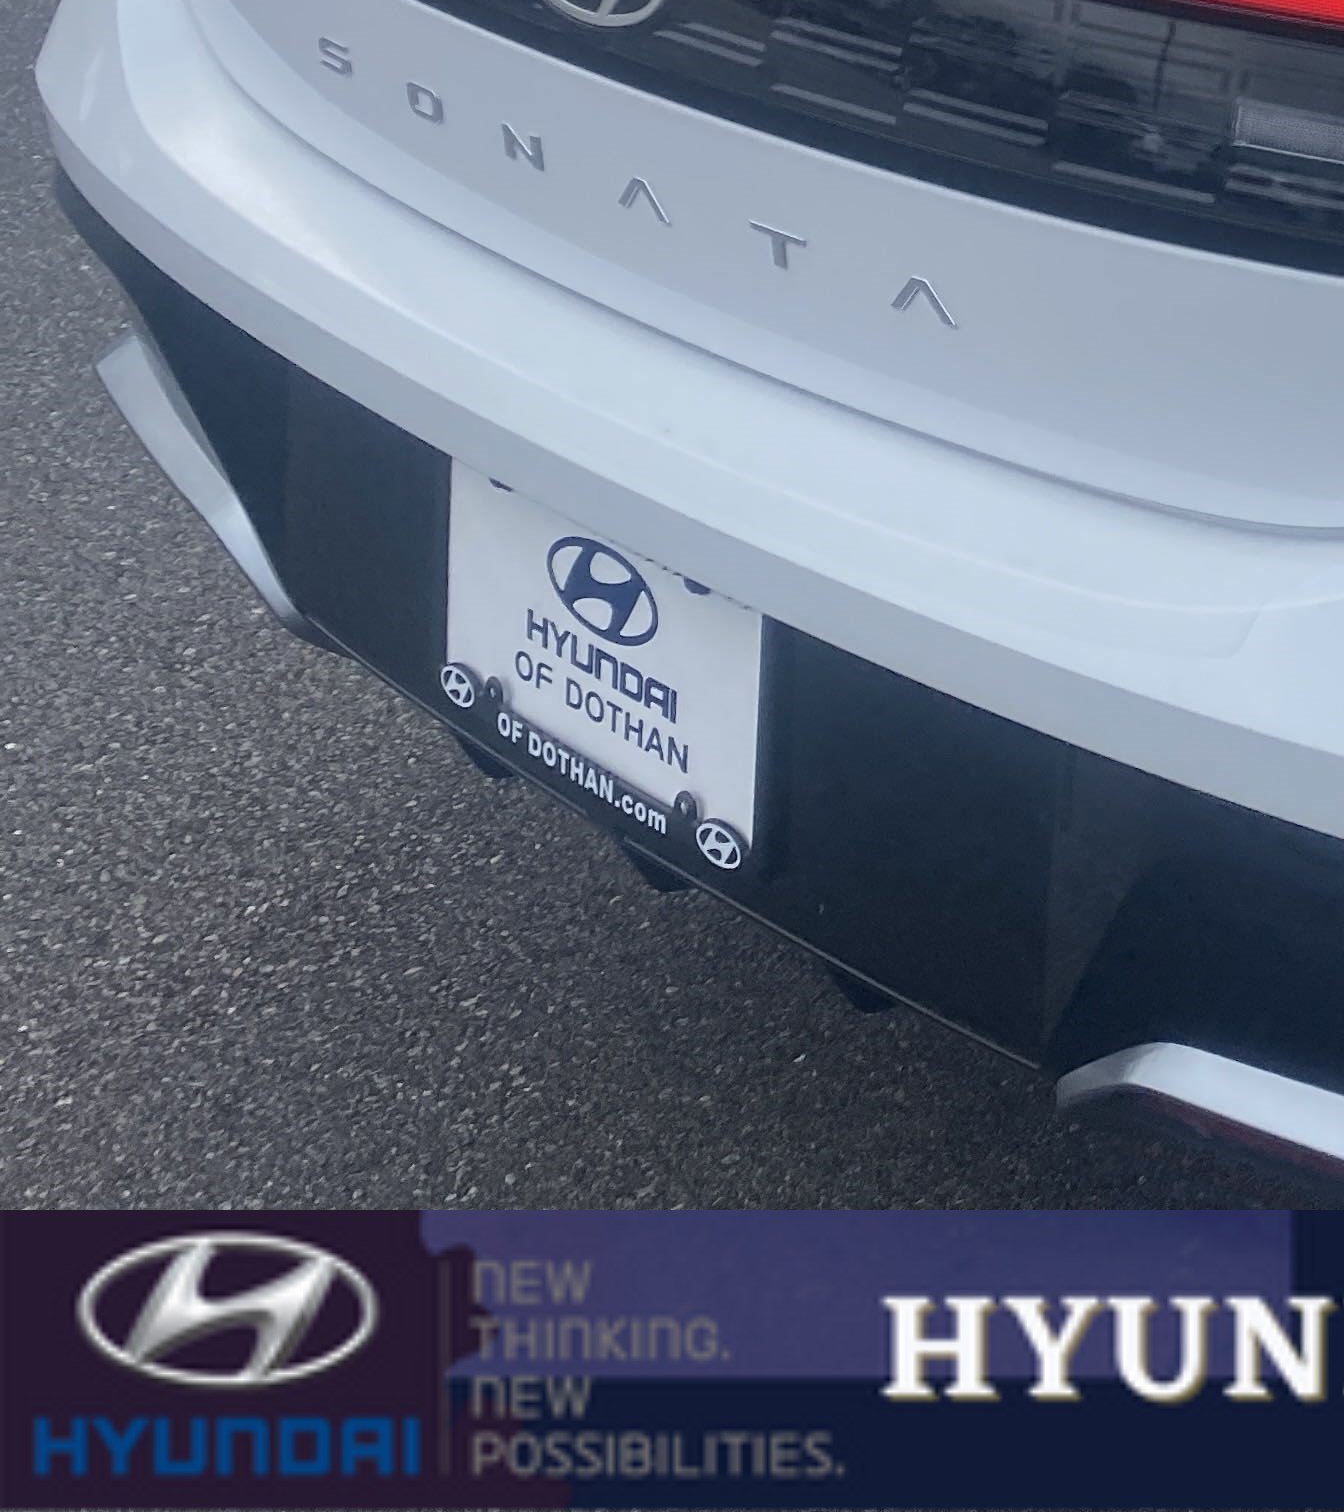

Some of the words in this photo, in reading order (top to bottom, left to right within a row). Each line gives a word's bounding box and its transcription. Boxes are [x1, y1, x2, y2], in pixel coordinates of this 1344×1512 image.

[318, 37, 957, 329] SONATA
[514, 650, 553, 690] OF
[565, 677, 689, 774] DOTHAN
[526, 608, 678, 724] HYUNDAI
[497, 711, 523, 744] OF
[528, 736, 667, 835] DOTHAN.com
